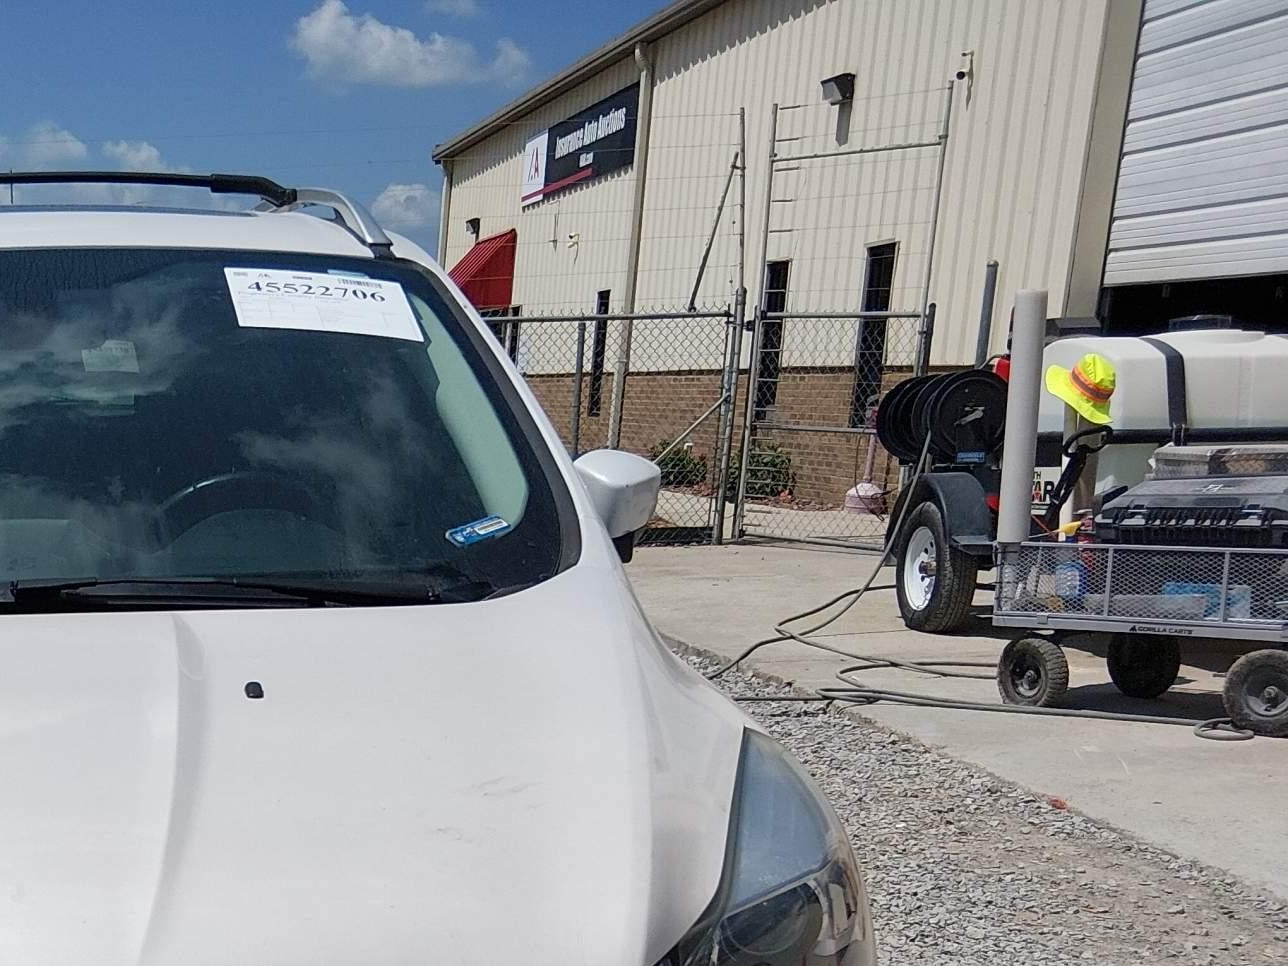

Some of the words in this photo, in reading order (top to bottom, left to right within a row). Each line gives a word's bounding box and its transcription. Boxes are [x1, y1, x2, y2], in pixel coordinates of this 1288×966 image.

[554, 127, 585, 160] Insurance
[582, 120, 599, 147] Auto
[596, 106, 627, 141] Auctions
[247, 281, 386, 303] 45522706
